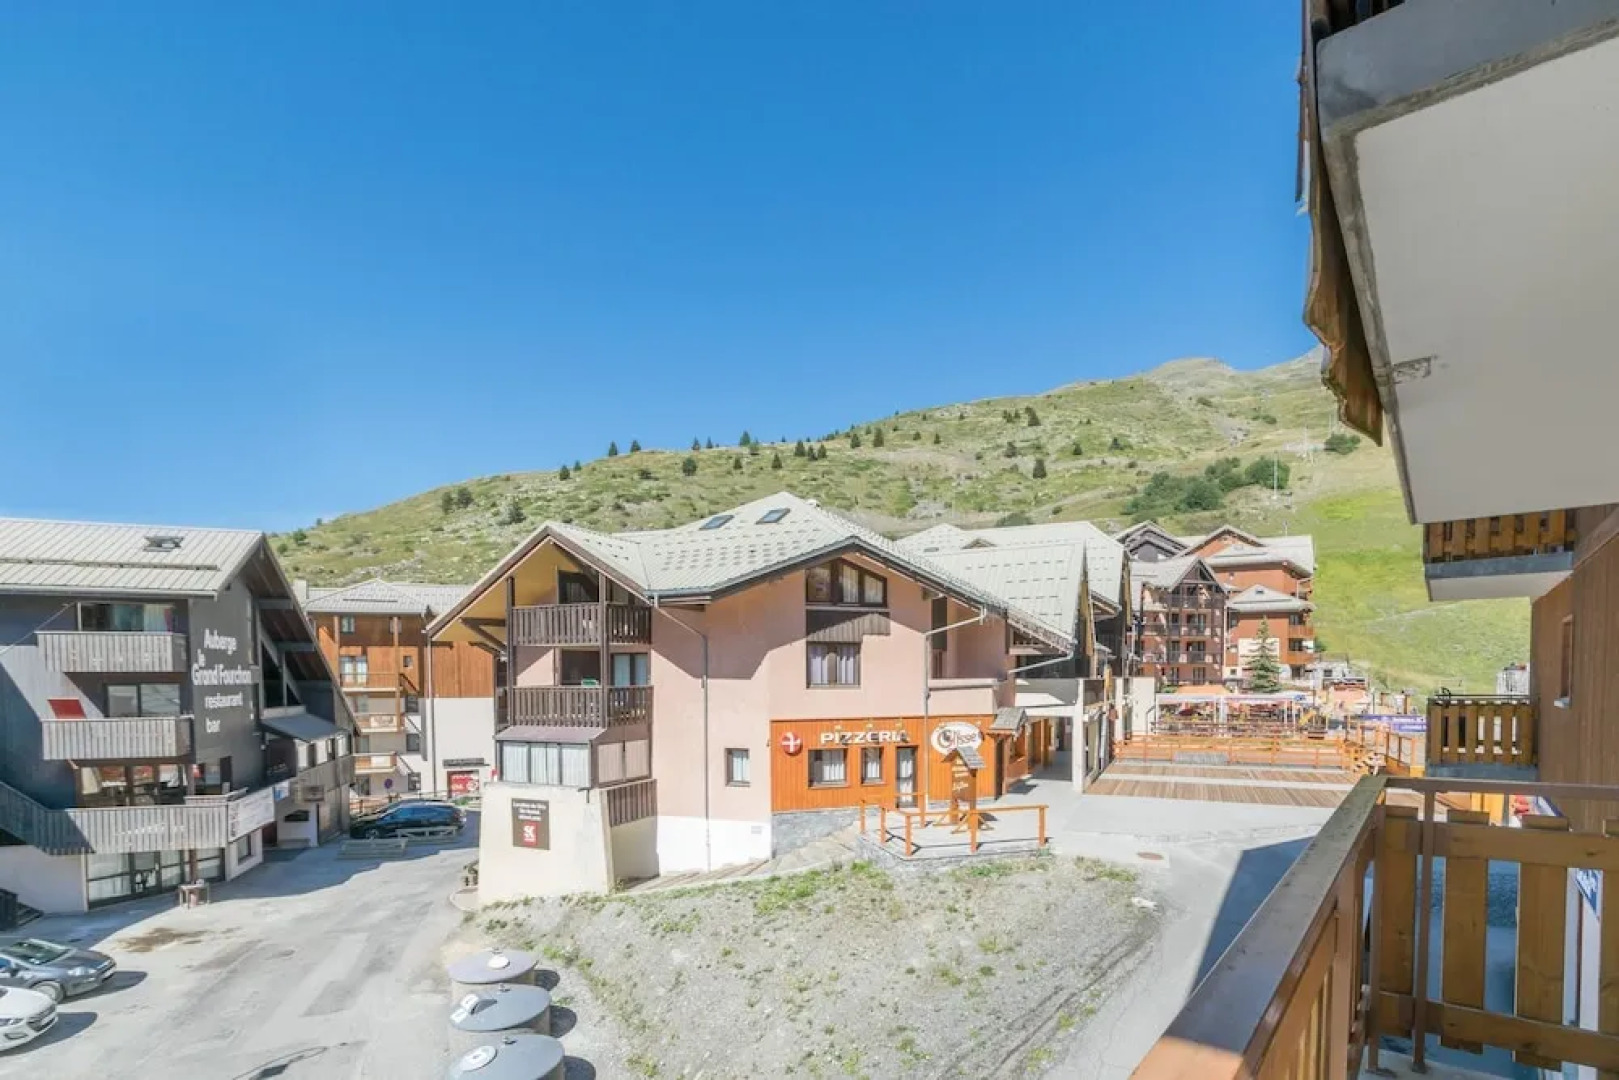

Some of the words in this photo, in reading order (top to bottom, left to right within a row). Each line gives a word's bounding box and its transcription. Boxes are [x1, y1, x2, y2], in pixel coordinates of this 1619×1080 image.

[204, 628, 237, 655] Auberge
[192, 663, 218, 686] Grand
[205, 691, 243, 709] restaurant
[205, 717, 221, 733] bar
[820, 731, 910, 744] PIZZERIA
